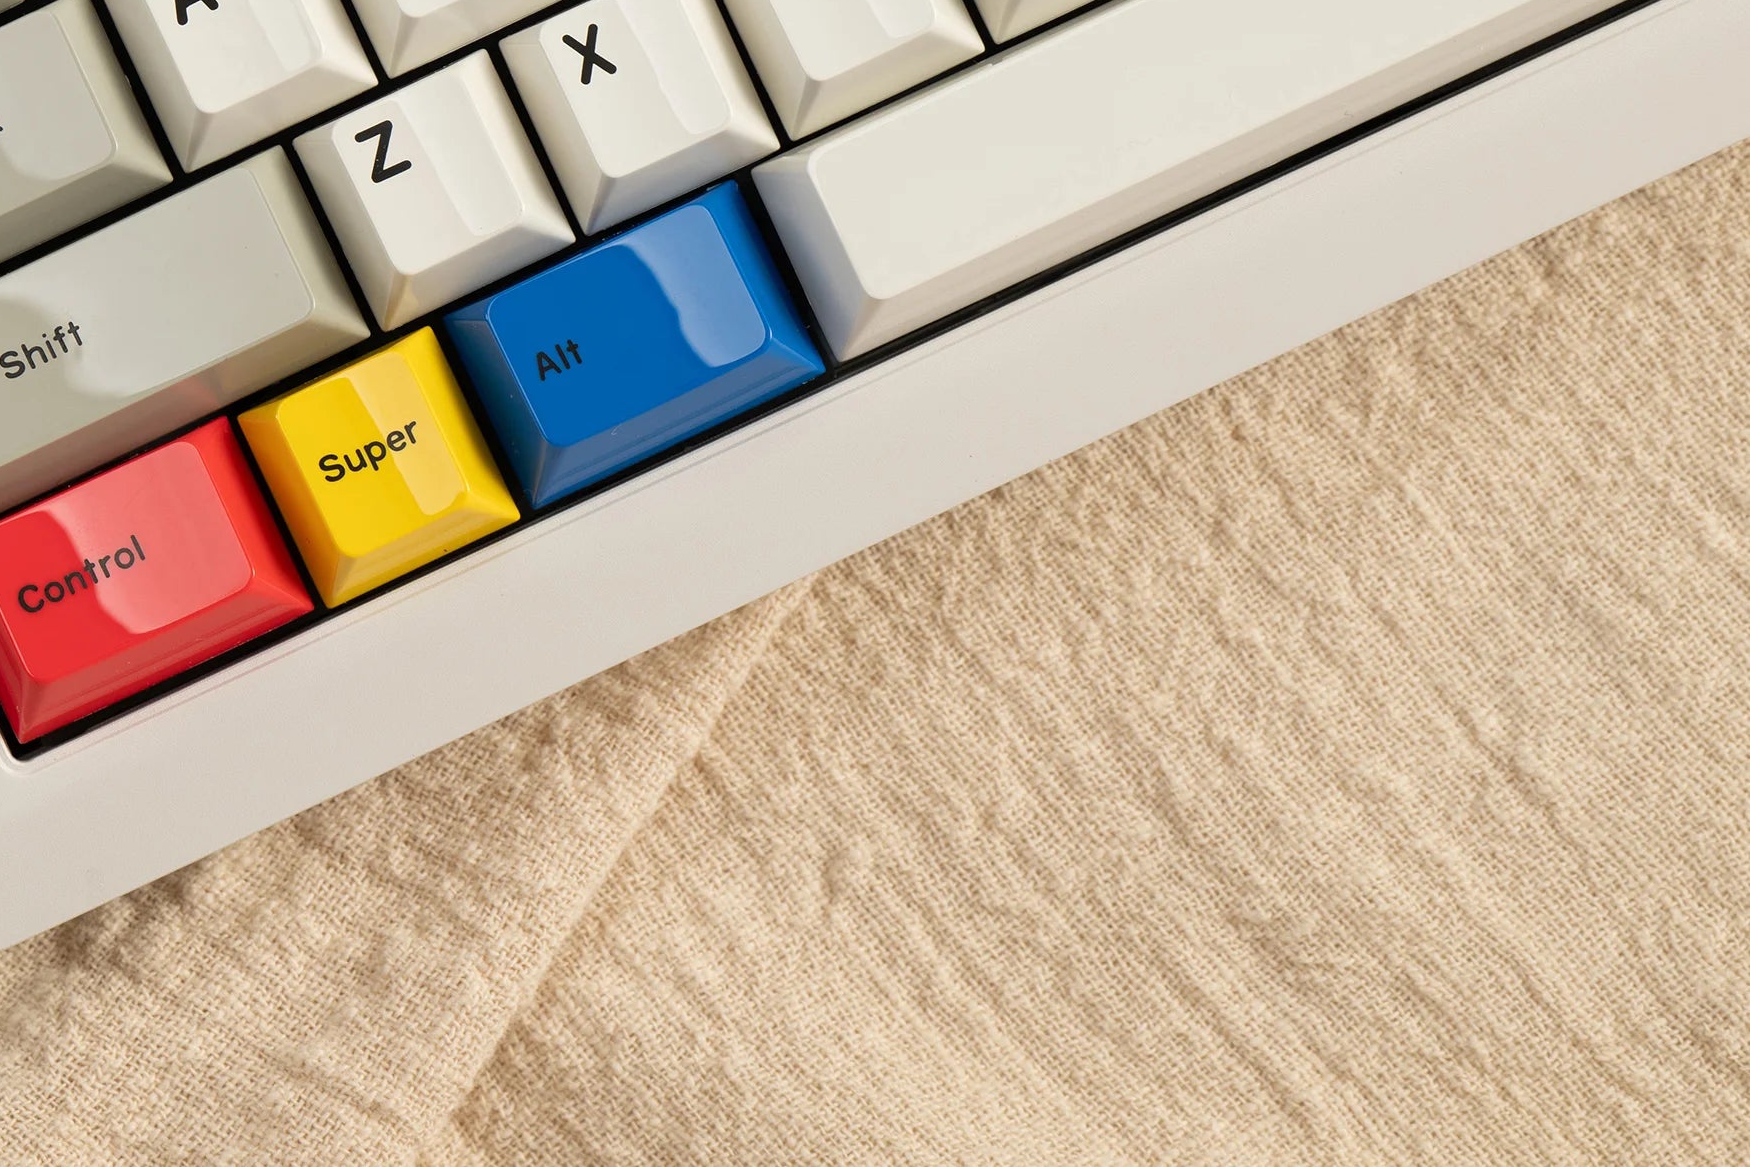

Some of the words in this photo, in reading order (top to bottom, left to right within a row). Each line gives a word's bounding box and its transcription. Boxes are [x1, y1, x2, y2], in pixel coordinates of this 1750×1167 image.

[561, 23, 618, 85] X
[354, 119, 412, 184] Z
[535, 339, 583, 382] Alt
[318, 420, 417, 483] Super
[17, 534, 146, 614] Control
